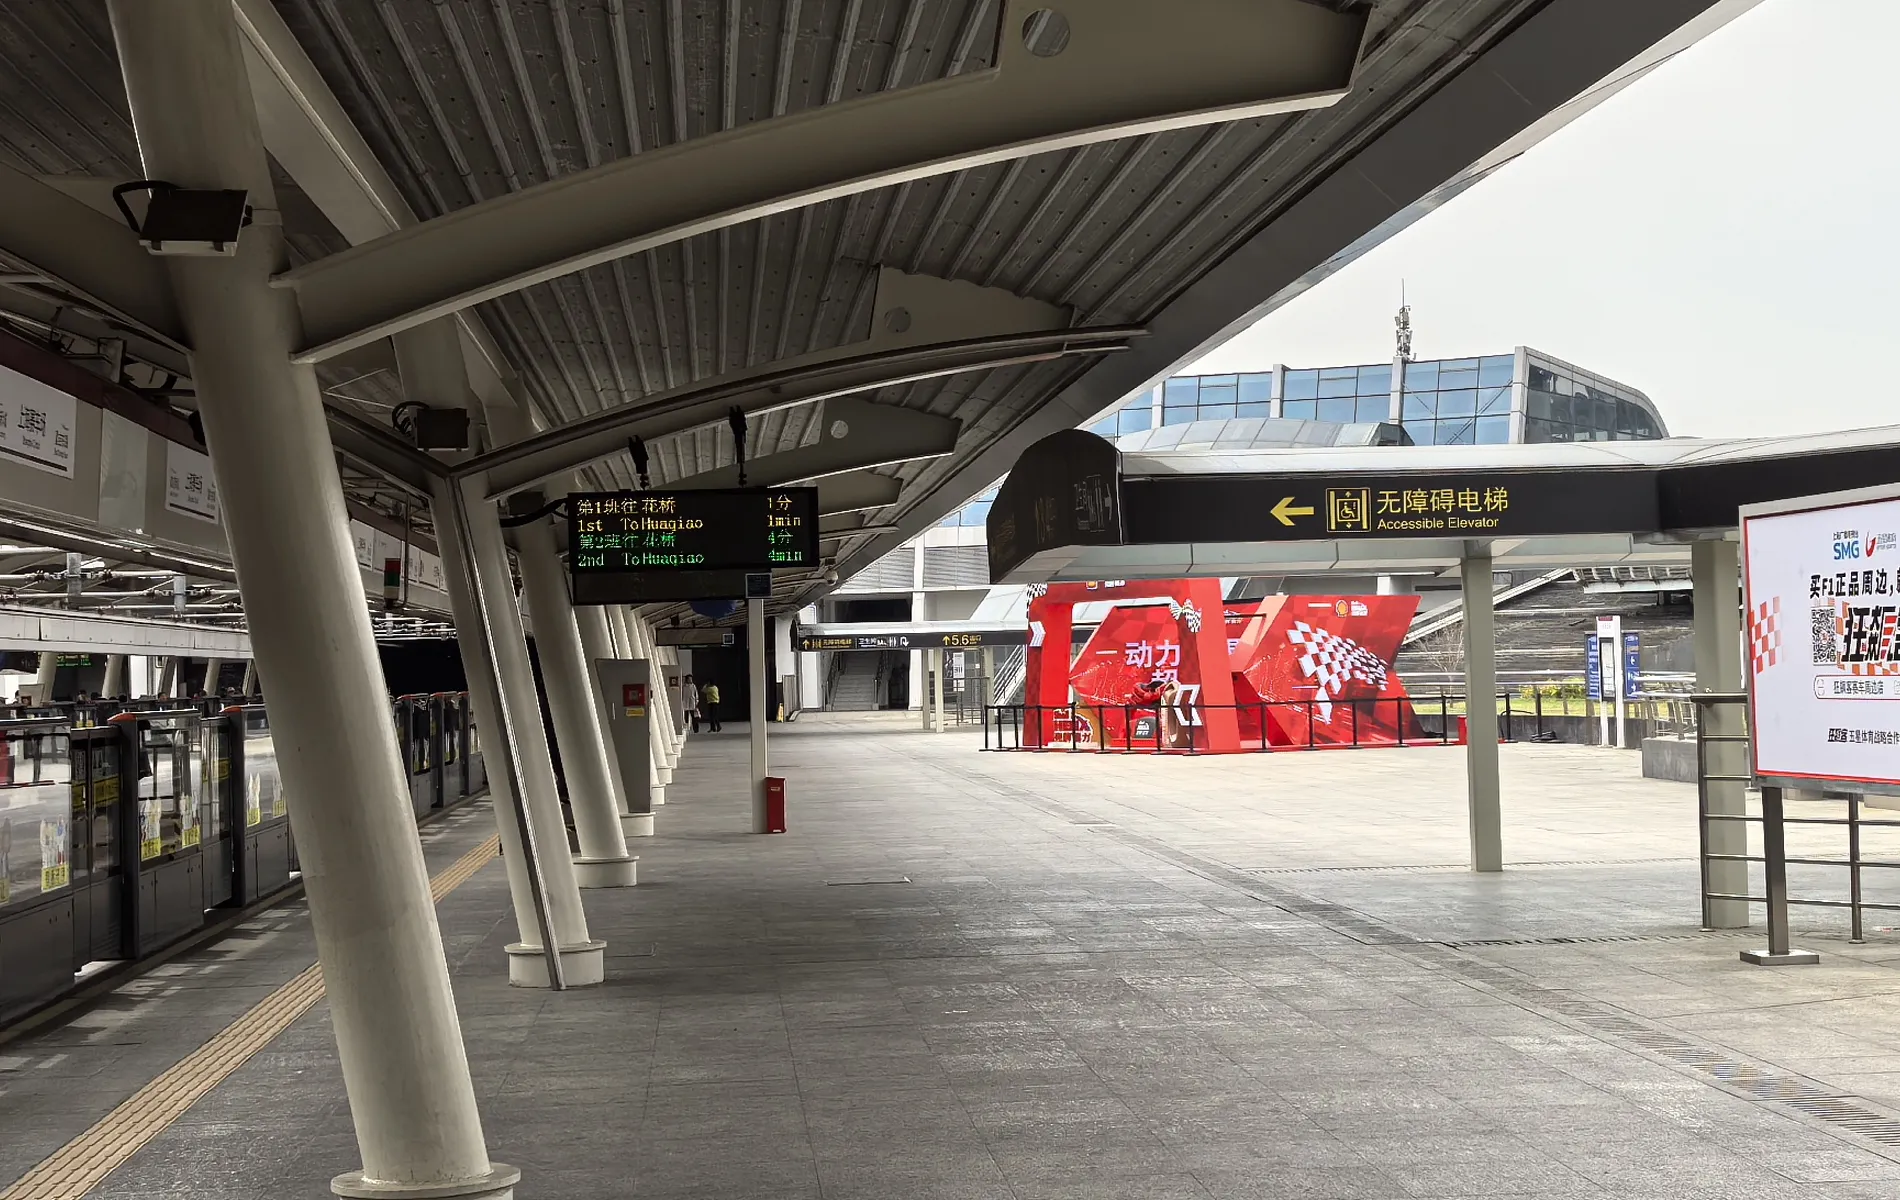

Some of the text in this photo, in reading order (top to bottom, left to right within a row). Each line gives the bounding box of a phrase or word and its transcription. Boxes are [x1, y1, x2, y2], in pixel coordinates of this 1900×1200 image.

[1376, 486, 1509, 514] 无障碍电梯
[577, 518, 604, 532] 1st
[620, 517, 639, 531] To
[767, 514, 801, 528] 1min
[1377, 516, 1500, 530] Accessible Elevator
[577, 553, 605, 567] 2nd
[624, 552, 640, 566] To
[1833, 540, 1860, 560] SMG
[1841, 605, 1900, 662] 狂飙
[1124, 640, 1181, 668] 动力
